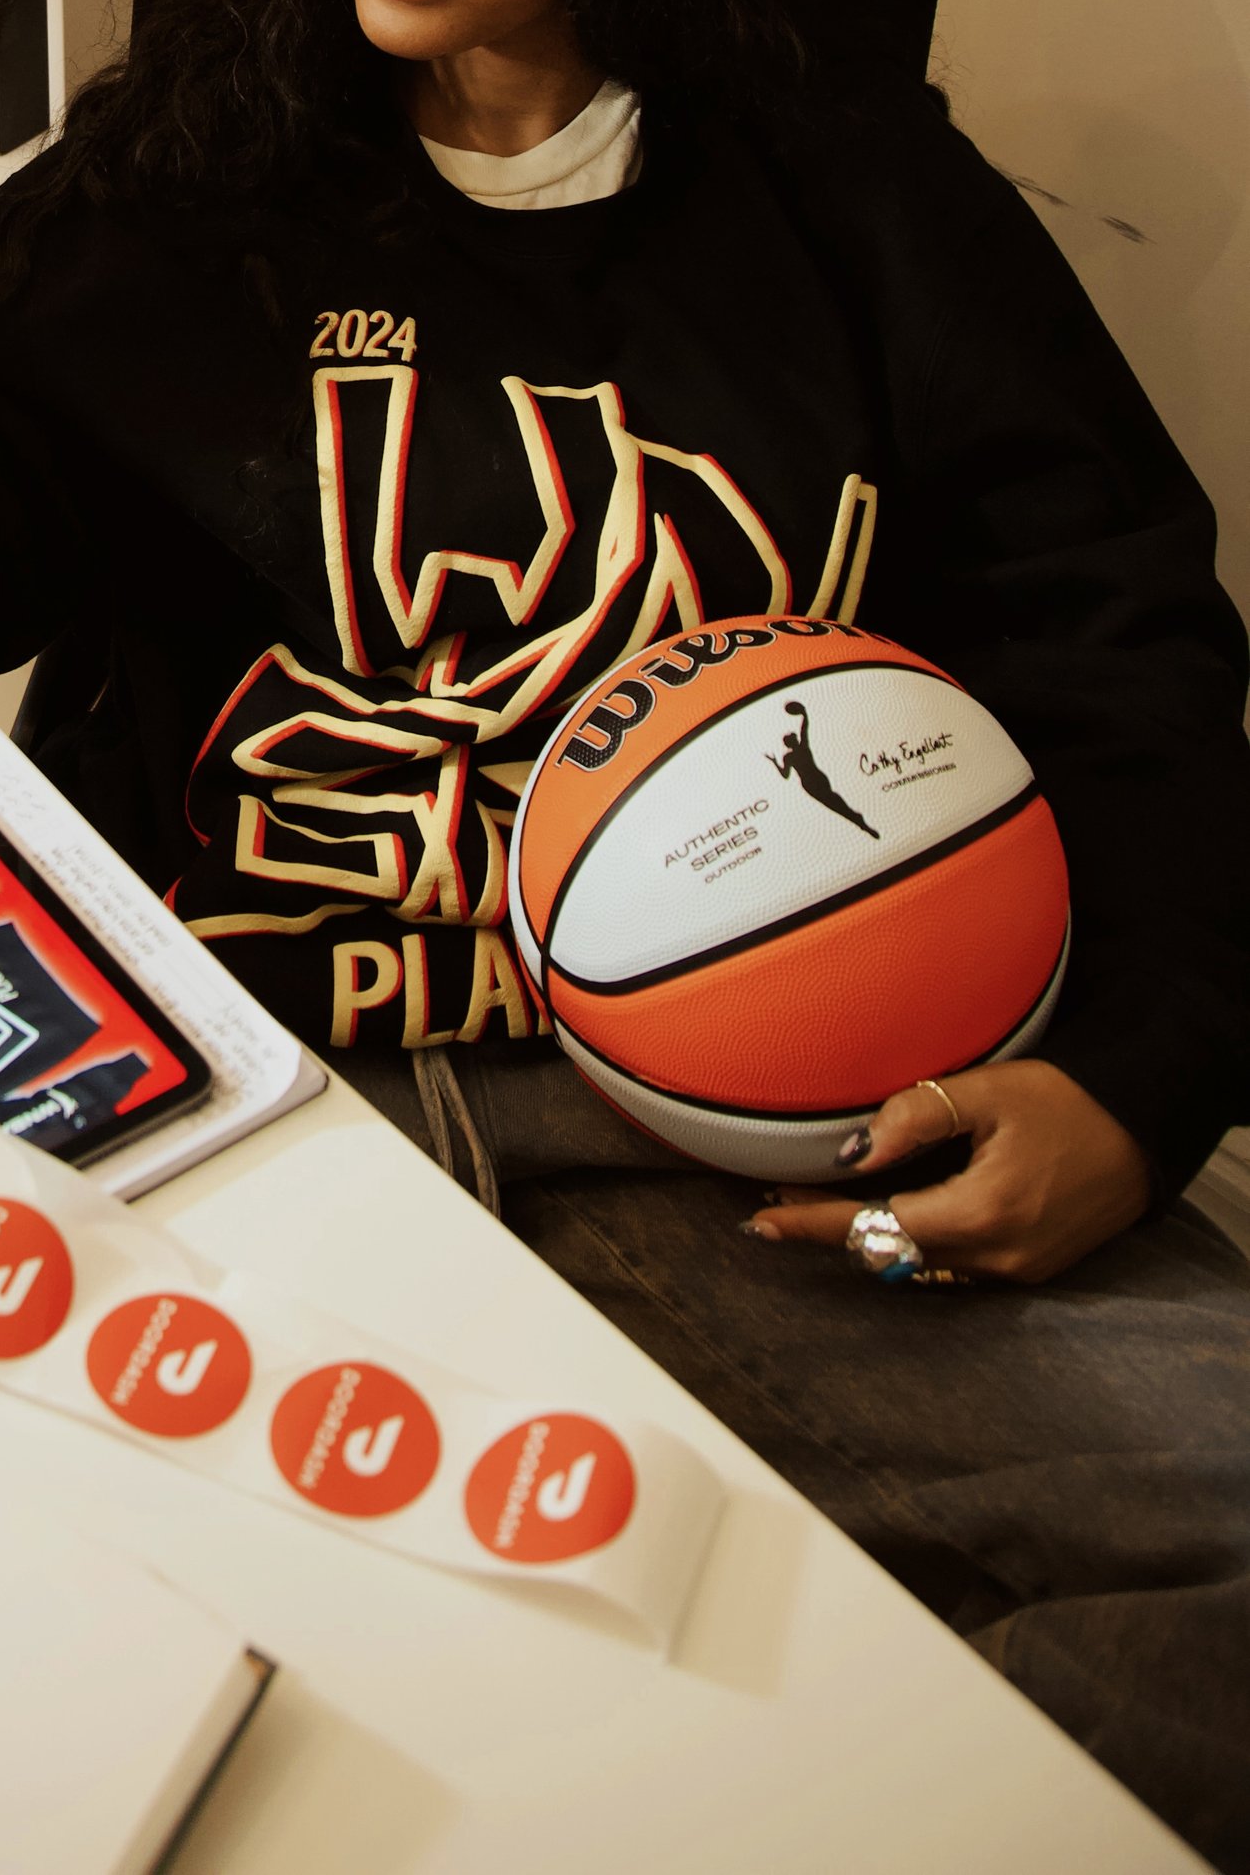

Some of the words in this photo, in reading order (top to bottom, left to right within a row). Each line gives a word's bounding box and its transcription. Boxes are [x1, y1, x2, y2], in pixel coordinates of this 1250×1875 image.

[308, 309, 420, 362] 2024
[859, 749, 903, 777] Cathy
[664, 799, 770, 869] AUTHENTIC
[690, 826, 759, 872] SERIES
[704, 846, 762, 884] OUTDOOR
[329, 927, 556, 1050] PLA
